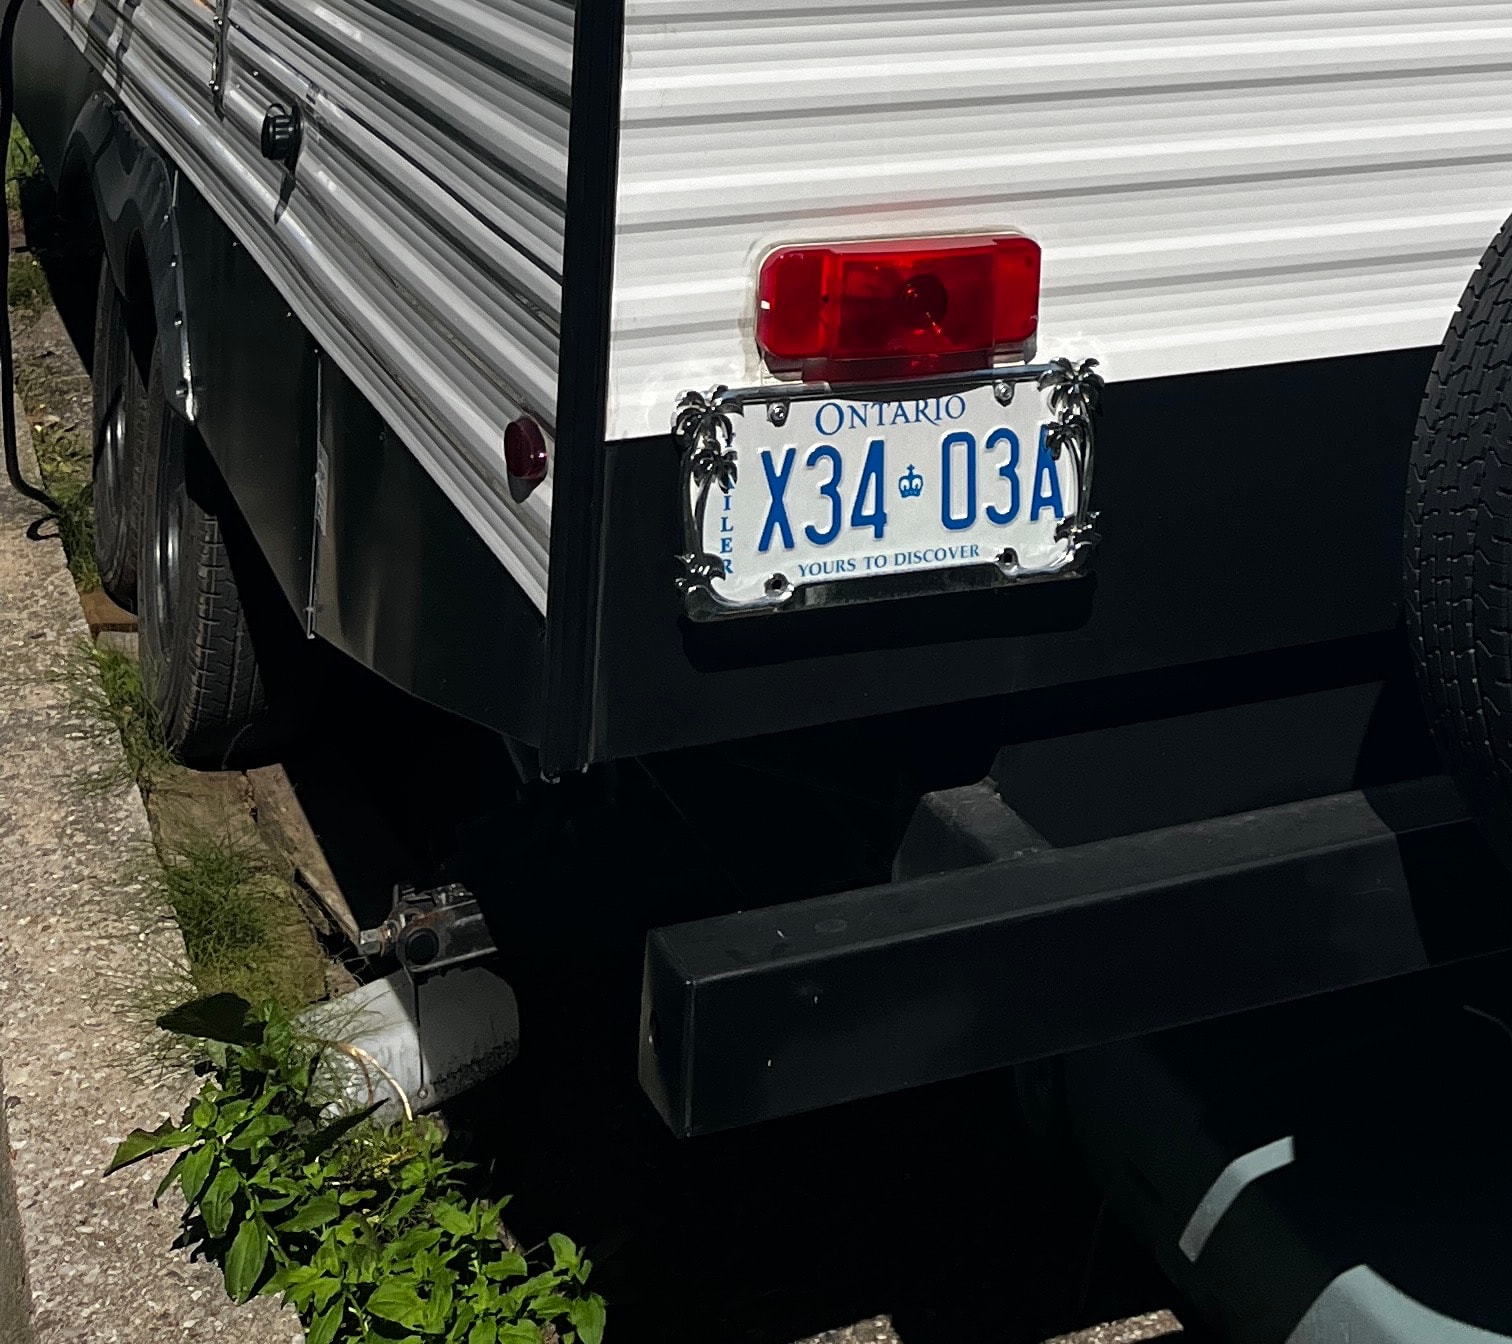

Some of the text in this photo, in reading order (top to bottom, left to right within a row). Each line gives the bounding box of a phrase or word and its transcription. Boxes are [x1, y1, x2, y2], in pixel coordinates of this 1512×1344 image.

[815, 395, 966, 436] ONTARIO
[757, 424, 1065, 553] X34 03A
[798, 543, 981, 578] YOURS TO DISCOVER
